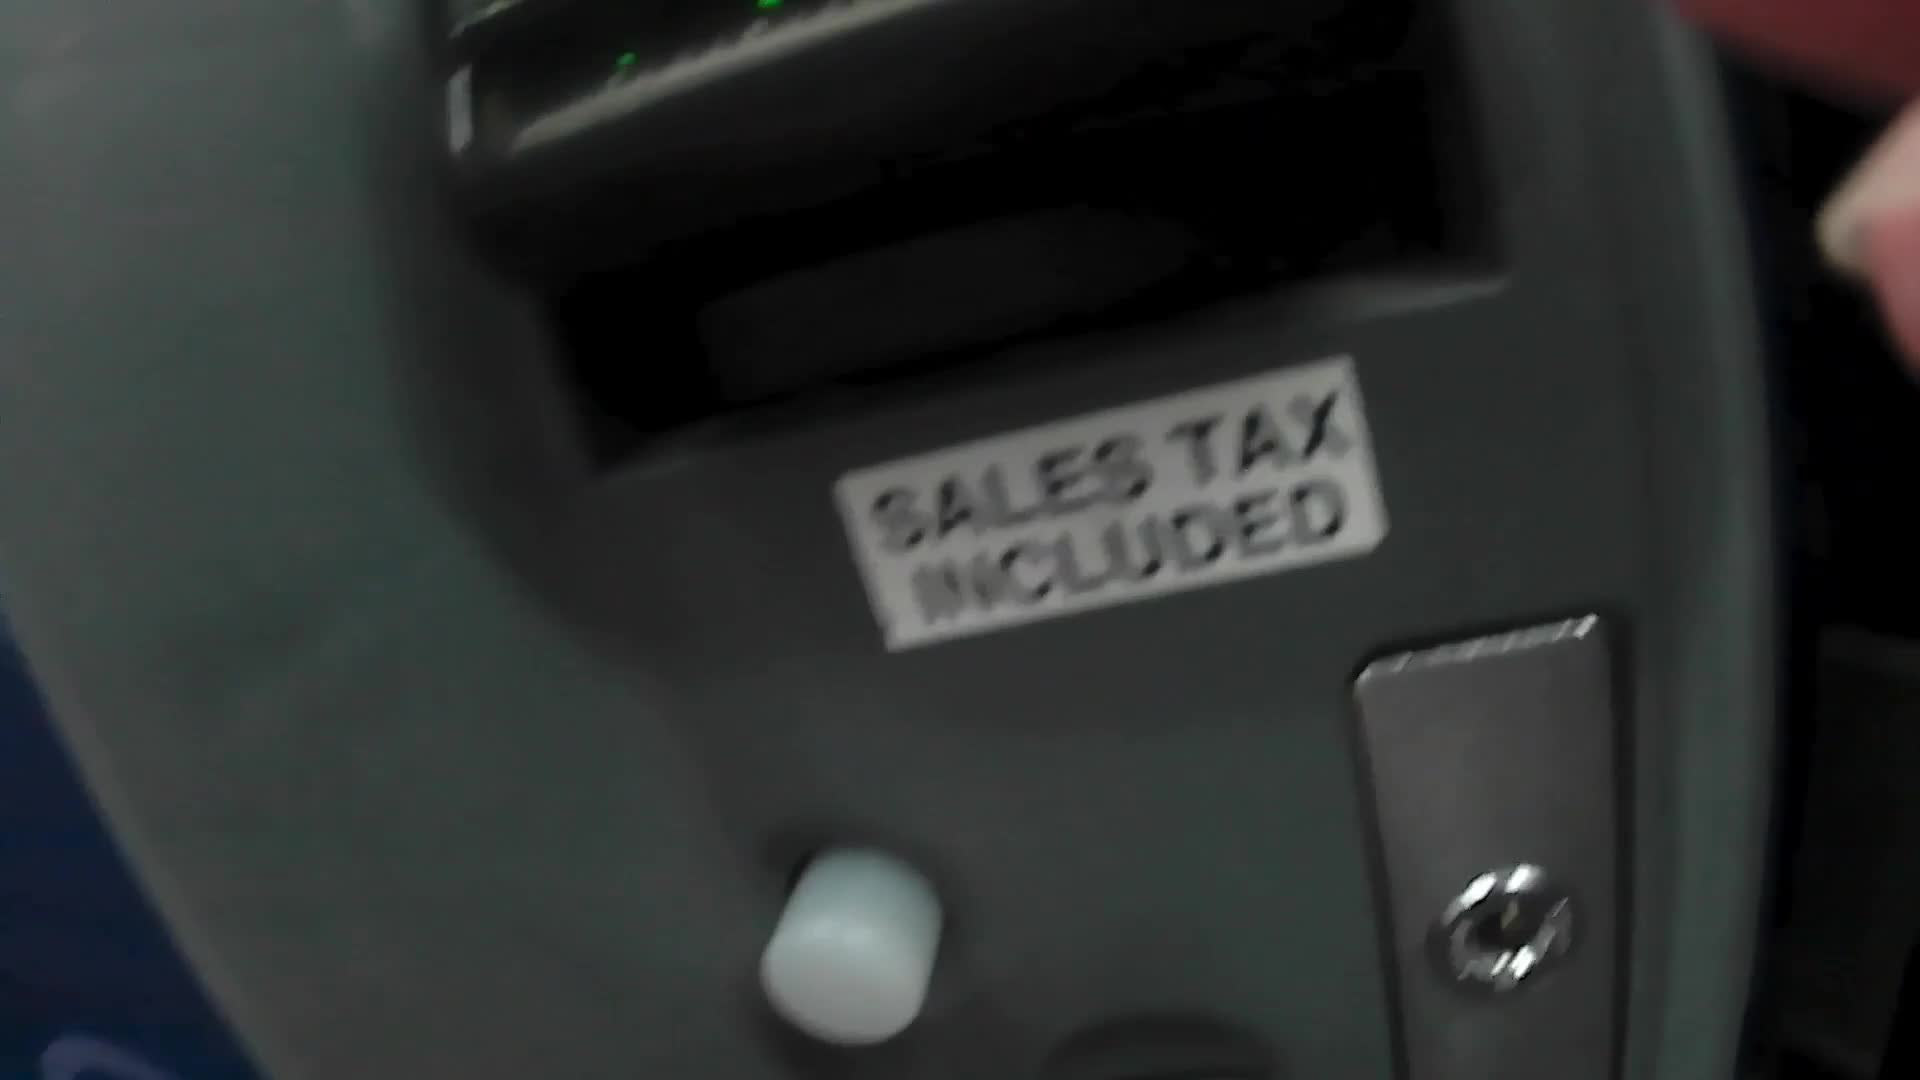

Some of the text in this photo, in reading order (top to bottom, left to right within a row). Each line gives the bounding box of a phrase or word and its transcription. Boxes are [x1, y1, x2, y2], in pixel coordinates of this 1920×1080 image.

[870, 393, 1350, 552] SALES TAX
[911, 476, 1346, 624] INCLUDED
